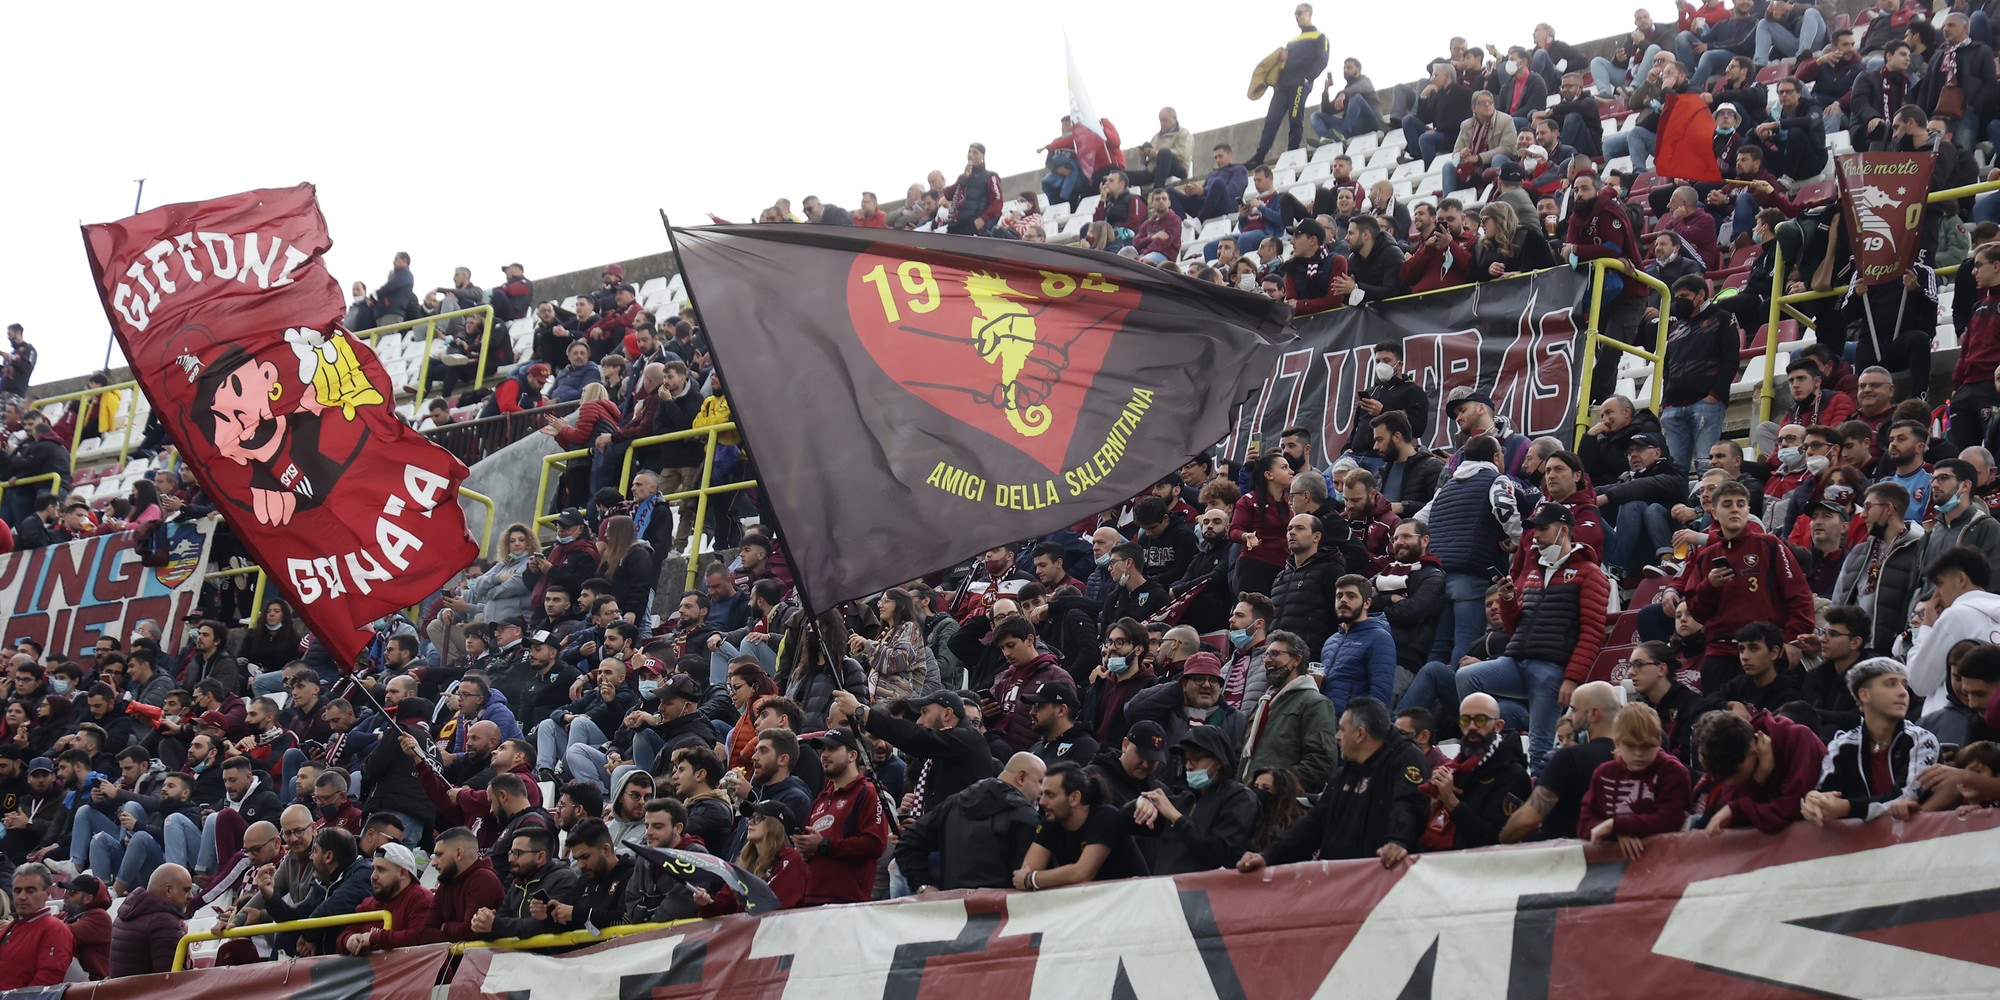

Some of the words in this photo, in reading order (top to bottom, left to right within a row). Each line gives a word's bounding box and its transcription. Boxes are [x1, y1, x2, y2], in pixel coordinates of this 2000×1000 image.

[1291, 85, 1303, 118] GIVOVA
[1873, 158, 1920, 175] morte
[1862, 236, 1884, 251] 19
[861, 261, 941, 323] 19
[1321, 286, 1580, 466] UTRAS
[925, 461, 986, 502] AMICI
[995, 479, 1061, 511] DELLA
[1063, 386, 1155, 497] SALERNITANA
[1748, 576, 1759, 593] 3
